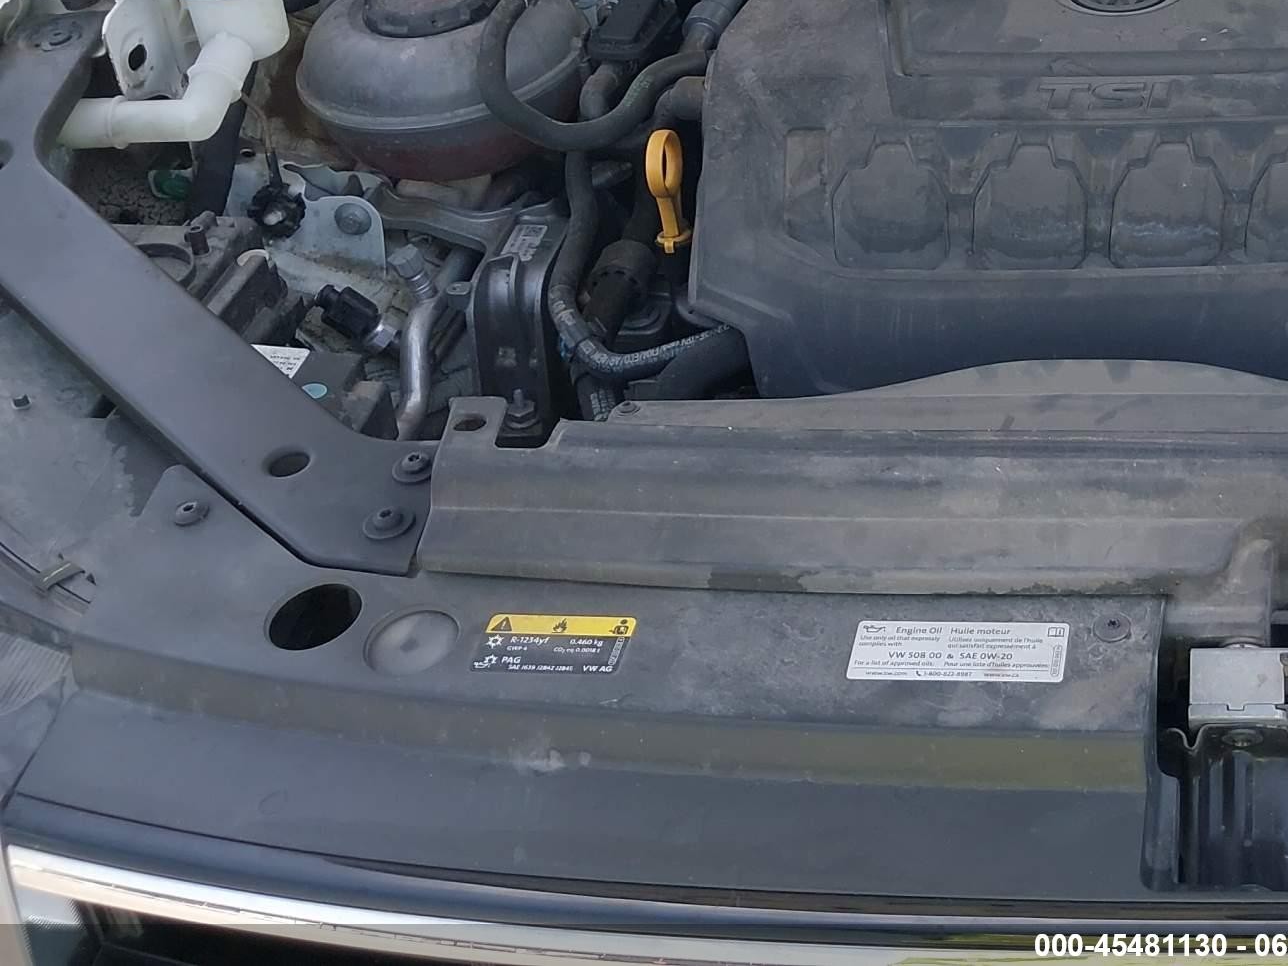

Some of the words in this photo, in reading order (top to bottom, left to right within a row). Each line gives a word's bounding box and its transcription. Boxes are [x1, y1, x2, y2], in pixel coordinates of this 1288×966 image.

[1037, 80, 1172, 110] TSI
[896, 627, 927, 635] Engine
[951, 627, 974, 635] Huile
[510, 636, 550, 646] R-1234yf
[593, 639, 603, 647] kg
